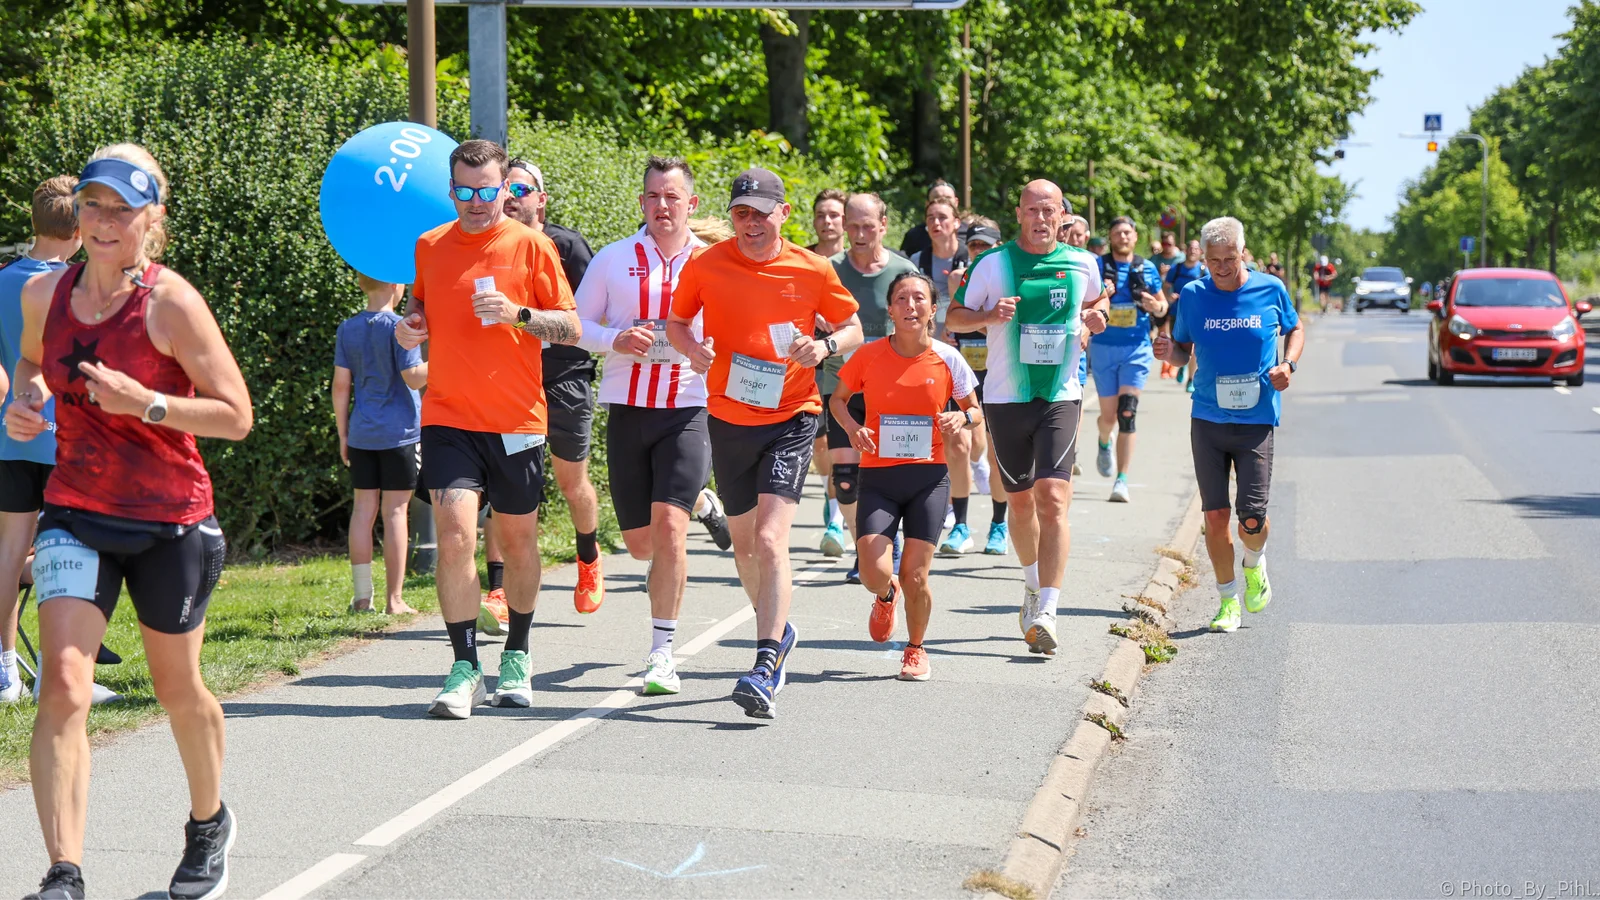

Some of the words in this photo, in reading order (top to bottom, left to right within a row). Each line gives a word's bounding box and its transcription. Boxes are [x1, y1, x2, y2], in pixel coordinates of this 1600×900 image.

[374, 127, 432, 193] 2:00
[1032, 342, 1055, 350] Tonni
[736, 358, 761, 370] FYNSKE
[762, 365, 782, 374] BANK
[740, 376, 768, 390] Jesper
[782, 467, 792, 475] DK
[34, 559, 83, 580] harlotte
